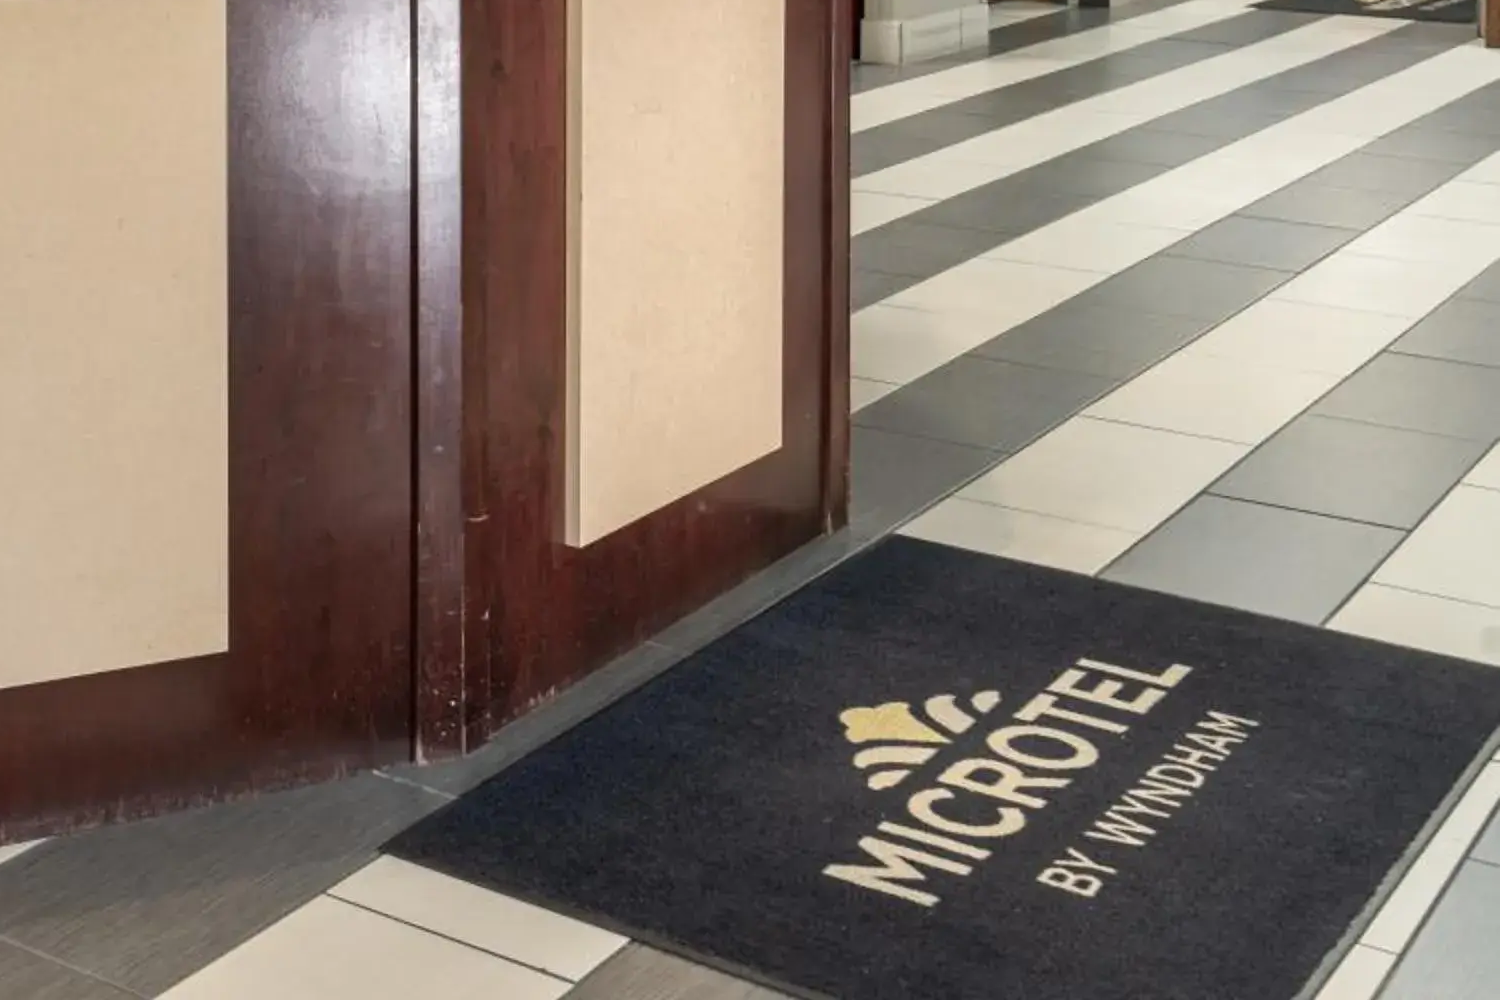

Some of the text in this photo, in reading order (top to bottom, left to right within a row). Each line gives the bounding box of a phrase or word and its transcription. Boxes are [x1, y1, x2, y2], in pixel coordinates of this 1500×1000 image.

[822, 658, 1194, 906] MICROTEL
[1036, 710, 1261, 898] BY WYNDHAM
